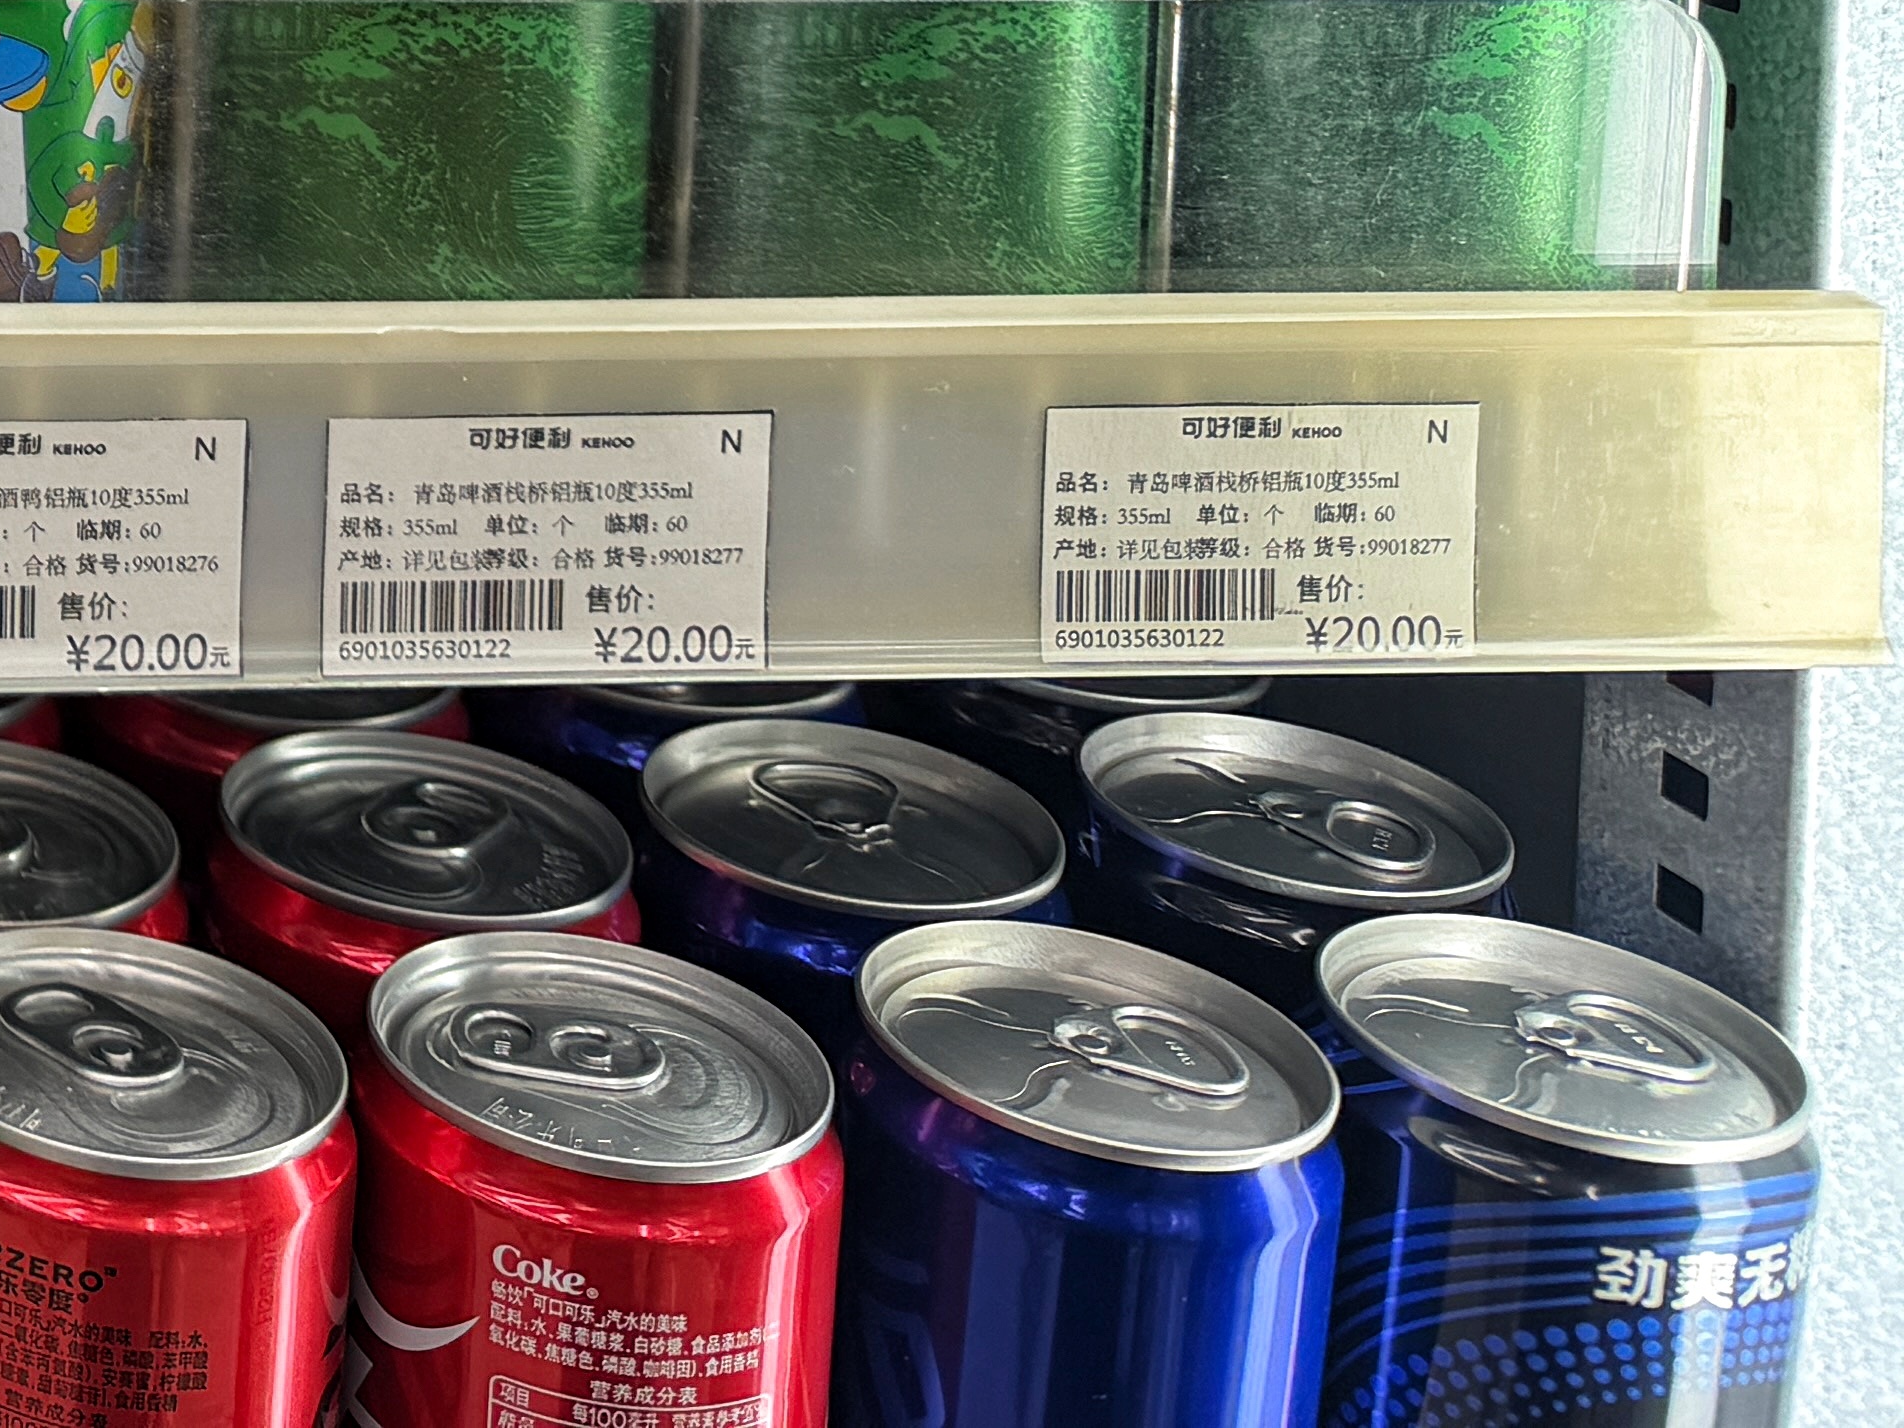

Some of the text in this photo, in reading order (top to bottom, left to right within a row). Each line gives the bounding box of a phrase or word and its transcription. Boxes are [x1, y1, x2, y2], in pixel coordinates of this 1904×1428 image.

[1181, 416, 1282, 440] 可好便利
[66, 632, 231, 673] ¥20.00元
[338, 638, 512, 661] 6901035630122
[593, 625, 756, 664] ¥20.00元
[5, 1246, 104, 1293] ZERO
[492, 1244, 586, 1295] Coke
[590, 1380, 698, 1406] 营养成分表
